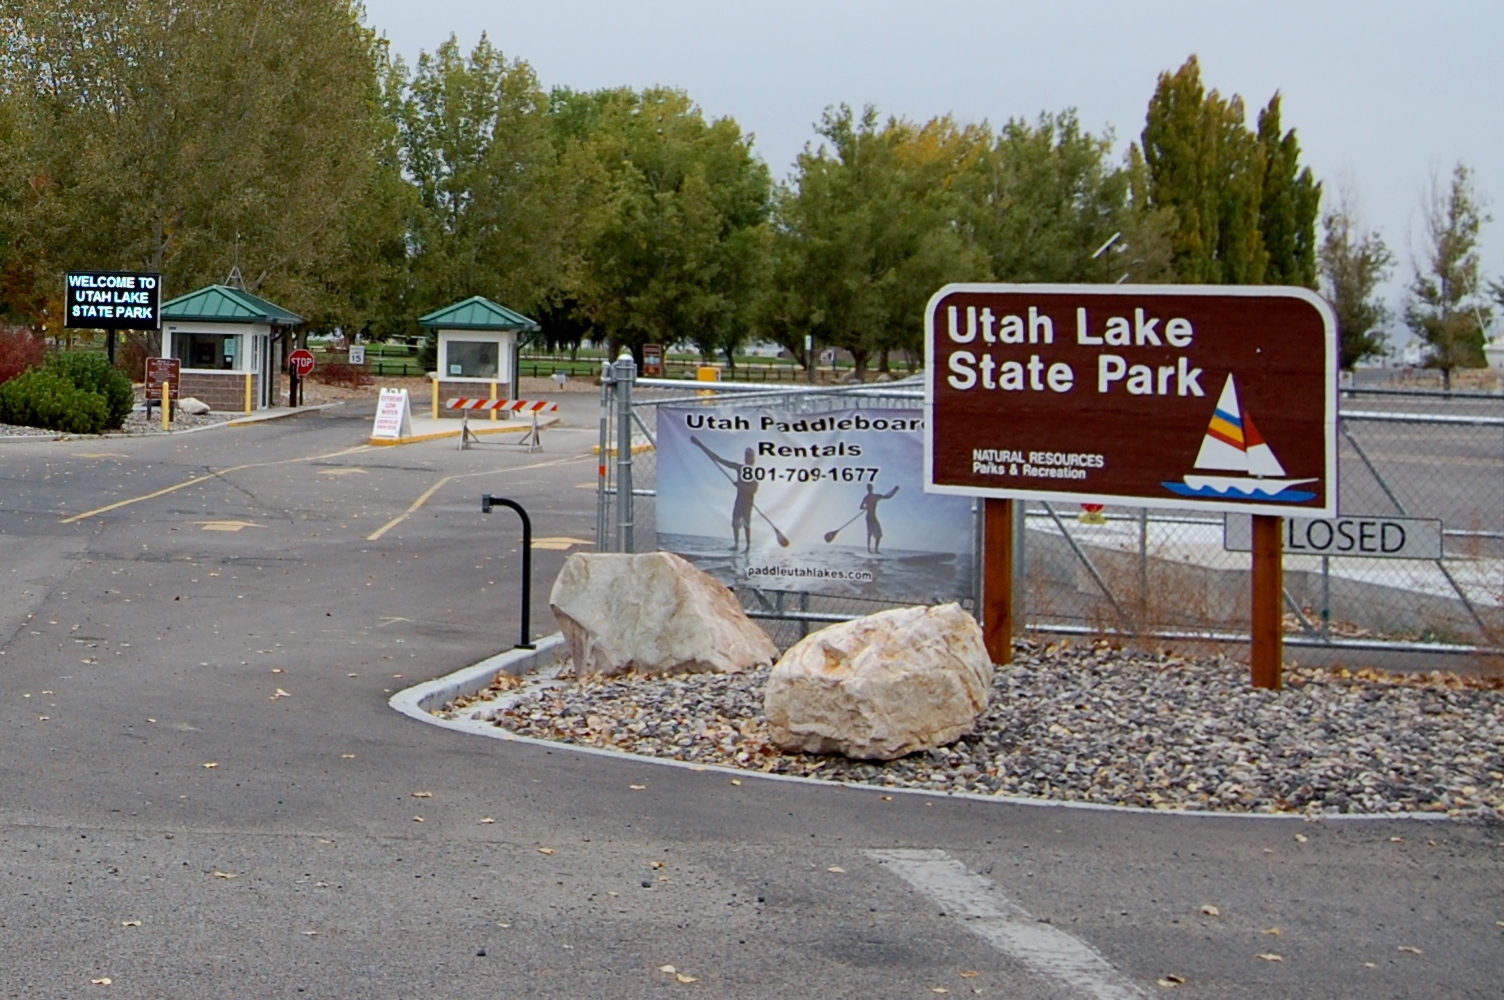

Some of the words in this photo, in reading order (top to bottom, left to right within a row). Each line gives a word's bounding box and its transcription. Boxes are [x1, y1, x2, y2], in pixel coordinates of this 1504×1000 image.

[69, 276, 135, 288] WELCOME
[138, 277, 155, 289] TO
[75, 291, 111, 302] UTAH
[113, 292, 149, 303] LAKE
[72, 305, 113, 317] STATE
[116, 306, 153, 319] PARK
[948, 306, 1053, 344] Utah
[1077, 307, 1193, 347] Lake
[351, 354, 362, 363] 15
[947, 351, 1074, 393] State
[1098, 354, 1204, 397] Park
[686, 414, 750, 431] Utah
[761, 415, 926, 432] Paddleboar
[758, 441, 862, 458] Rentals
[973, 449, 1026, 464] NATURAL
[1029, 451, 1104, 467] RESOURCES
[742, 466, 880, 483] 801-709-1677
[973, 462, 1005, 476] Parks
[1009, 464, 1019, 477] &
[1023, 464, 1087, 479] Recreation
[1286, 518, 1406, 553] LOSED
[748, 566, 873, 582] paddleutahlakes.com
